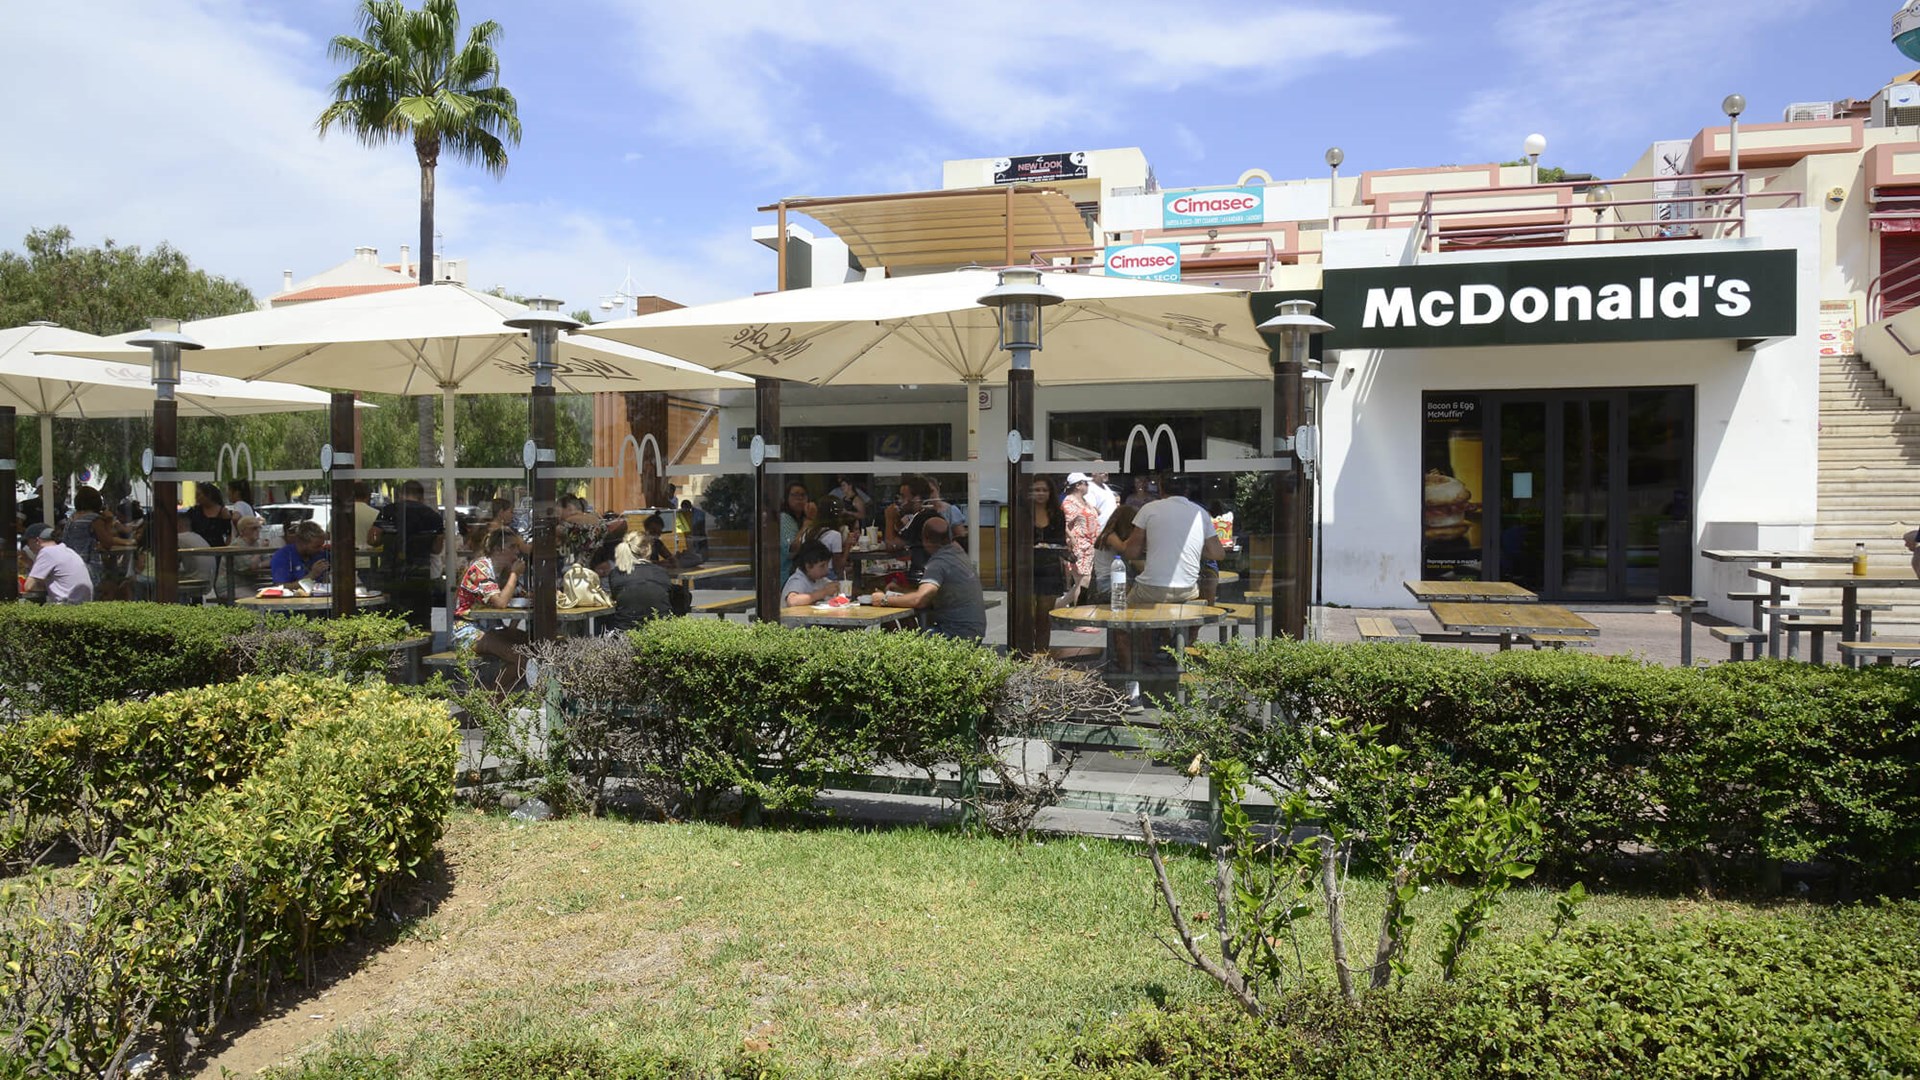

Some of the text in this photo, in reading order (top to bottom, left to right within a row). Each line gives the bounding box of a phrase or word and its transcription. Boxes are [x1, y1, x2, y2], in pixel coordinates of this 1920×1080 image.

[1017, 160, 1063, 171] NEW LOOK
[1173, 197, 1254, 213] Cimasec
[1110, 255, 1175, 269] Cimasec
[1361, 275, 1752, 329] McDonald's
[1427, 402, 1451, 410] Bacon
[1460, 401, 1475, 411] Egg
